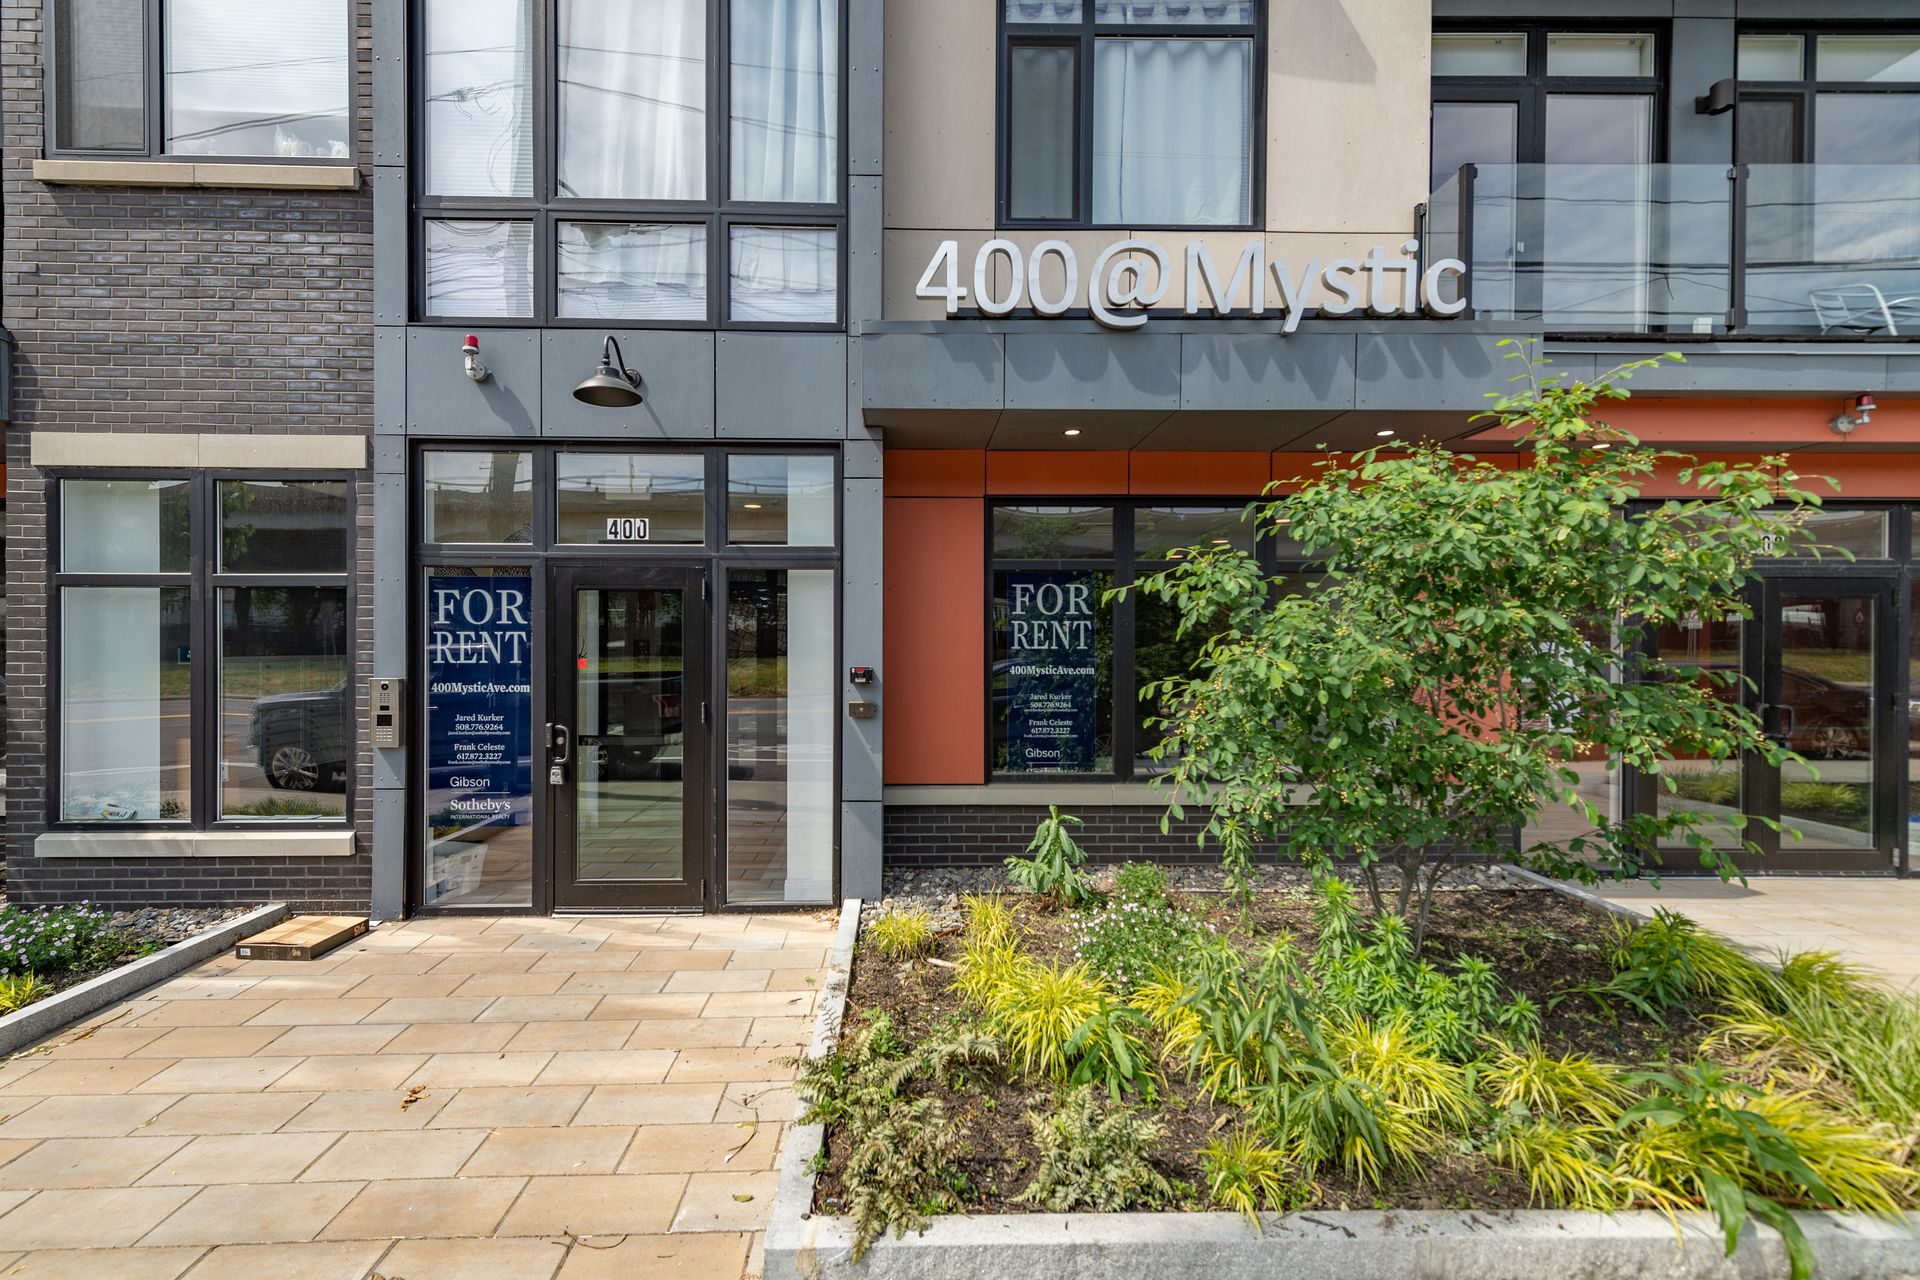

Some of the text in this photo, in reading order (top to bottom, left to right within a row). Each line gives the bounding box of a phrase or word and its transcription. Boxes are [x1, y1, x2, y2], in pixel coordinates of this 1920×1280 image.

[916, 238, 1467, 336] 400@Mystic
[609, 519, 646, 539] 400
[1012, 583, 1093, 615] FOR
[433, 588, 528, 625] FOR
[1011, 620, 1092, 650] RENT
[433, 631, 526, 664] RENT
[1009, 664, 1095, 676] 400MysticAve.com
[431, 682, 530, 694] 400MysticAve.com
[454, 714, 504, 722] Jared Kurker
[454, 743, 505, 751] Frank Celeste
[1025, 748, 1060, 758] Gibson
[456, 752, 502, 760] 617.872.3227
[450, 776, 490, 787] Gibson
[450, 798, 511, 813] Sotheby's
